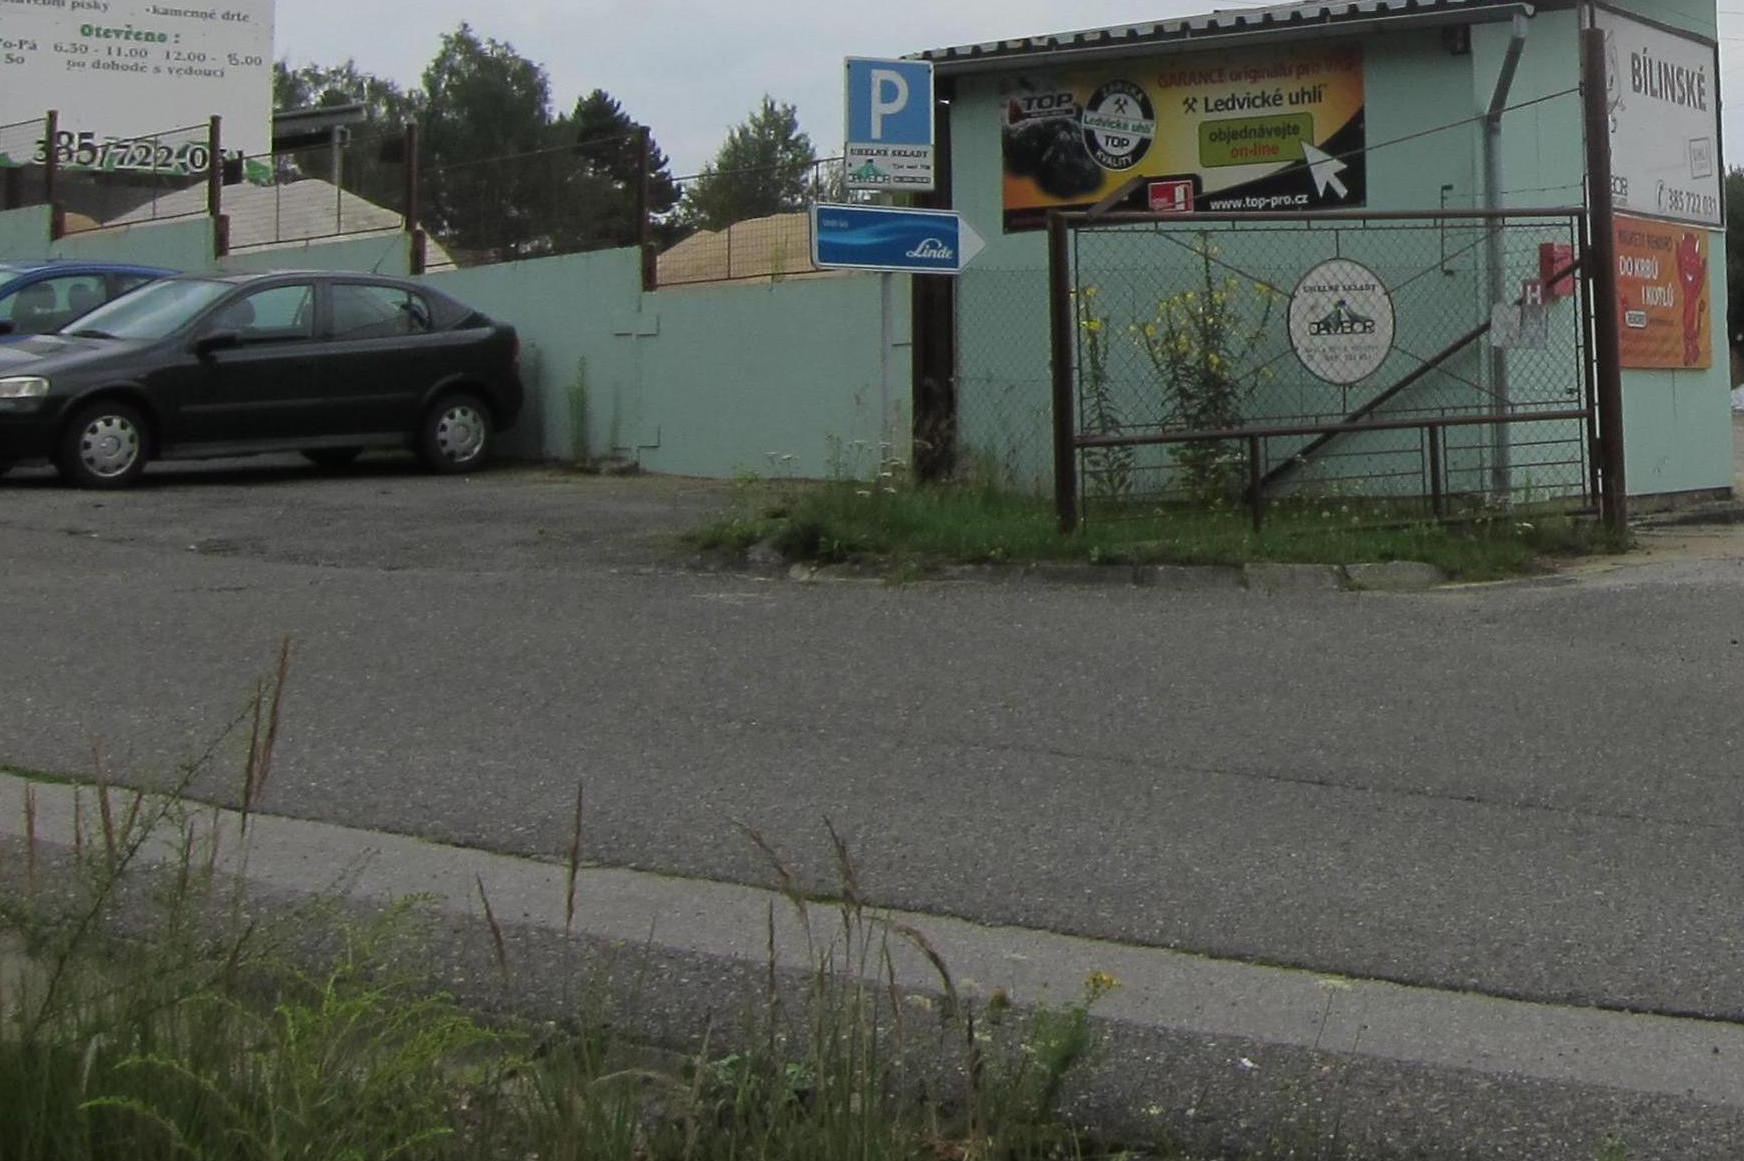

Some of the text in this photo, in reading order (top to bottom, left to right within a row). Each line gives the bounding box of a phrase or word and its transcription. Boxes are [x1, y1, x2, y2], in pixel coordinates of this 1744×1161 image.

[1631, 47, 1708, 112] BÍLINSKÉ
[870, 68, 909, 140] P
[1022, 92, 1074, 111] TOP
[1204, 88, 1284, 113] Ledvické
[1105, 134, 1130, 148] TOP
[1208, 122, 1300, 144] objednávejte
[1230, 143, 1280, 159] on-line
[1209, 192, 1309, 210] www.top-pro.cz
[905, 237, 953, 260] Linde
